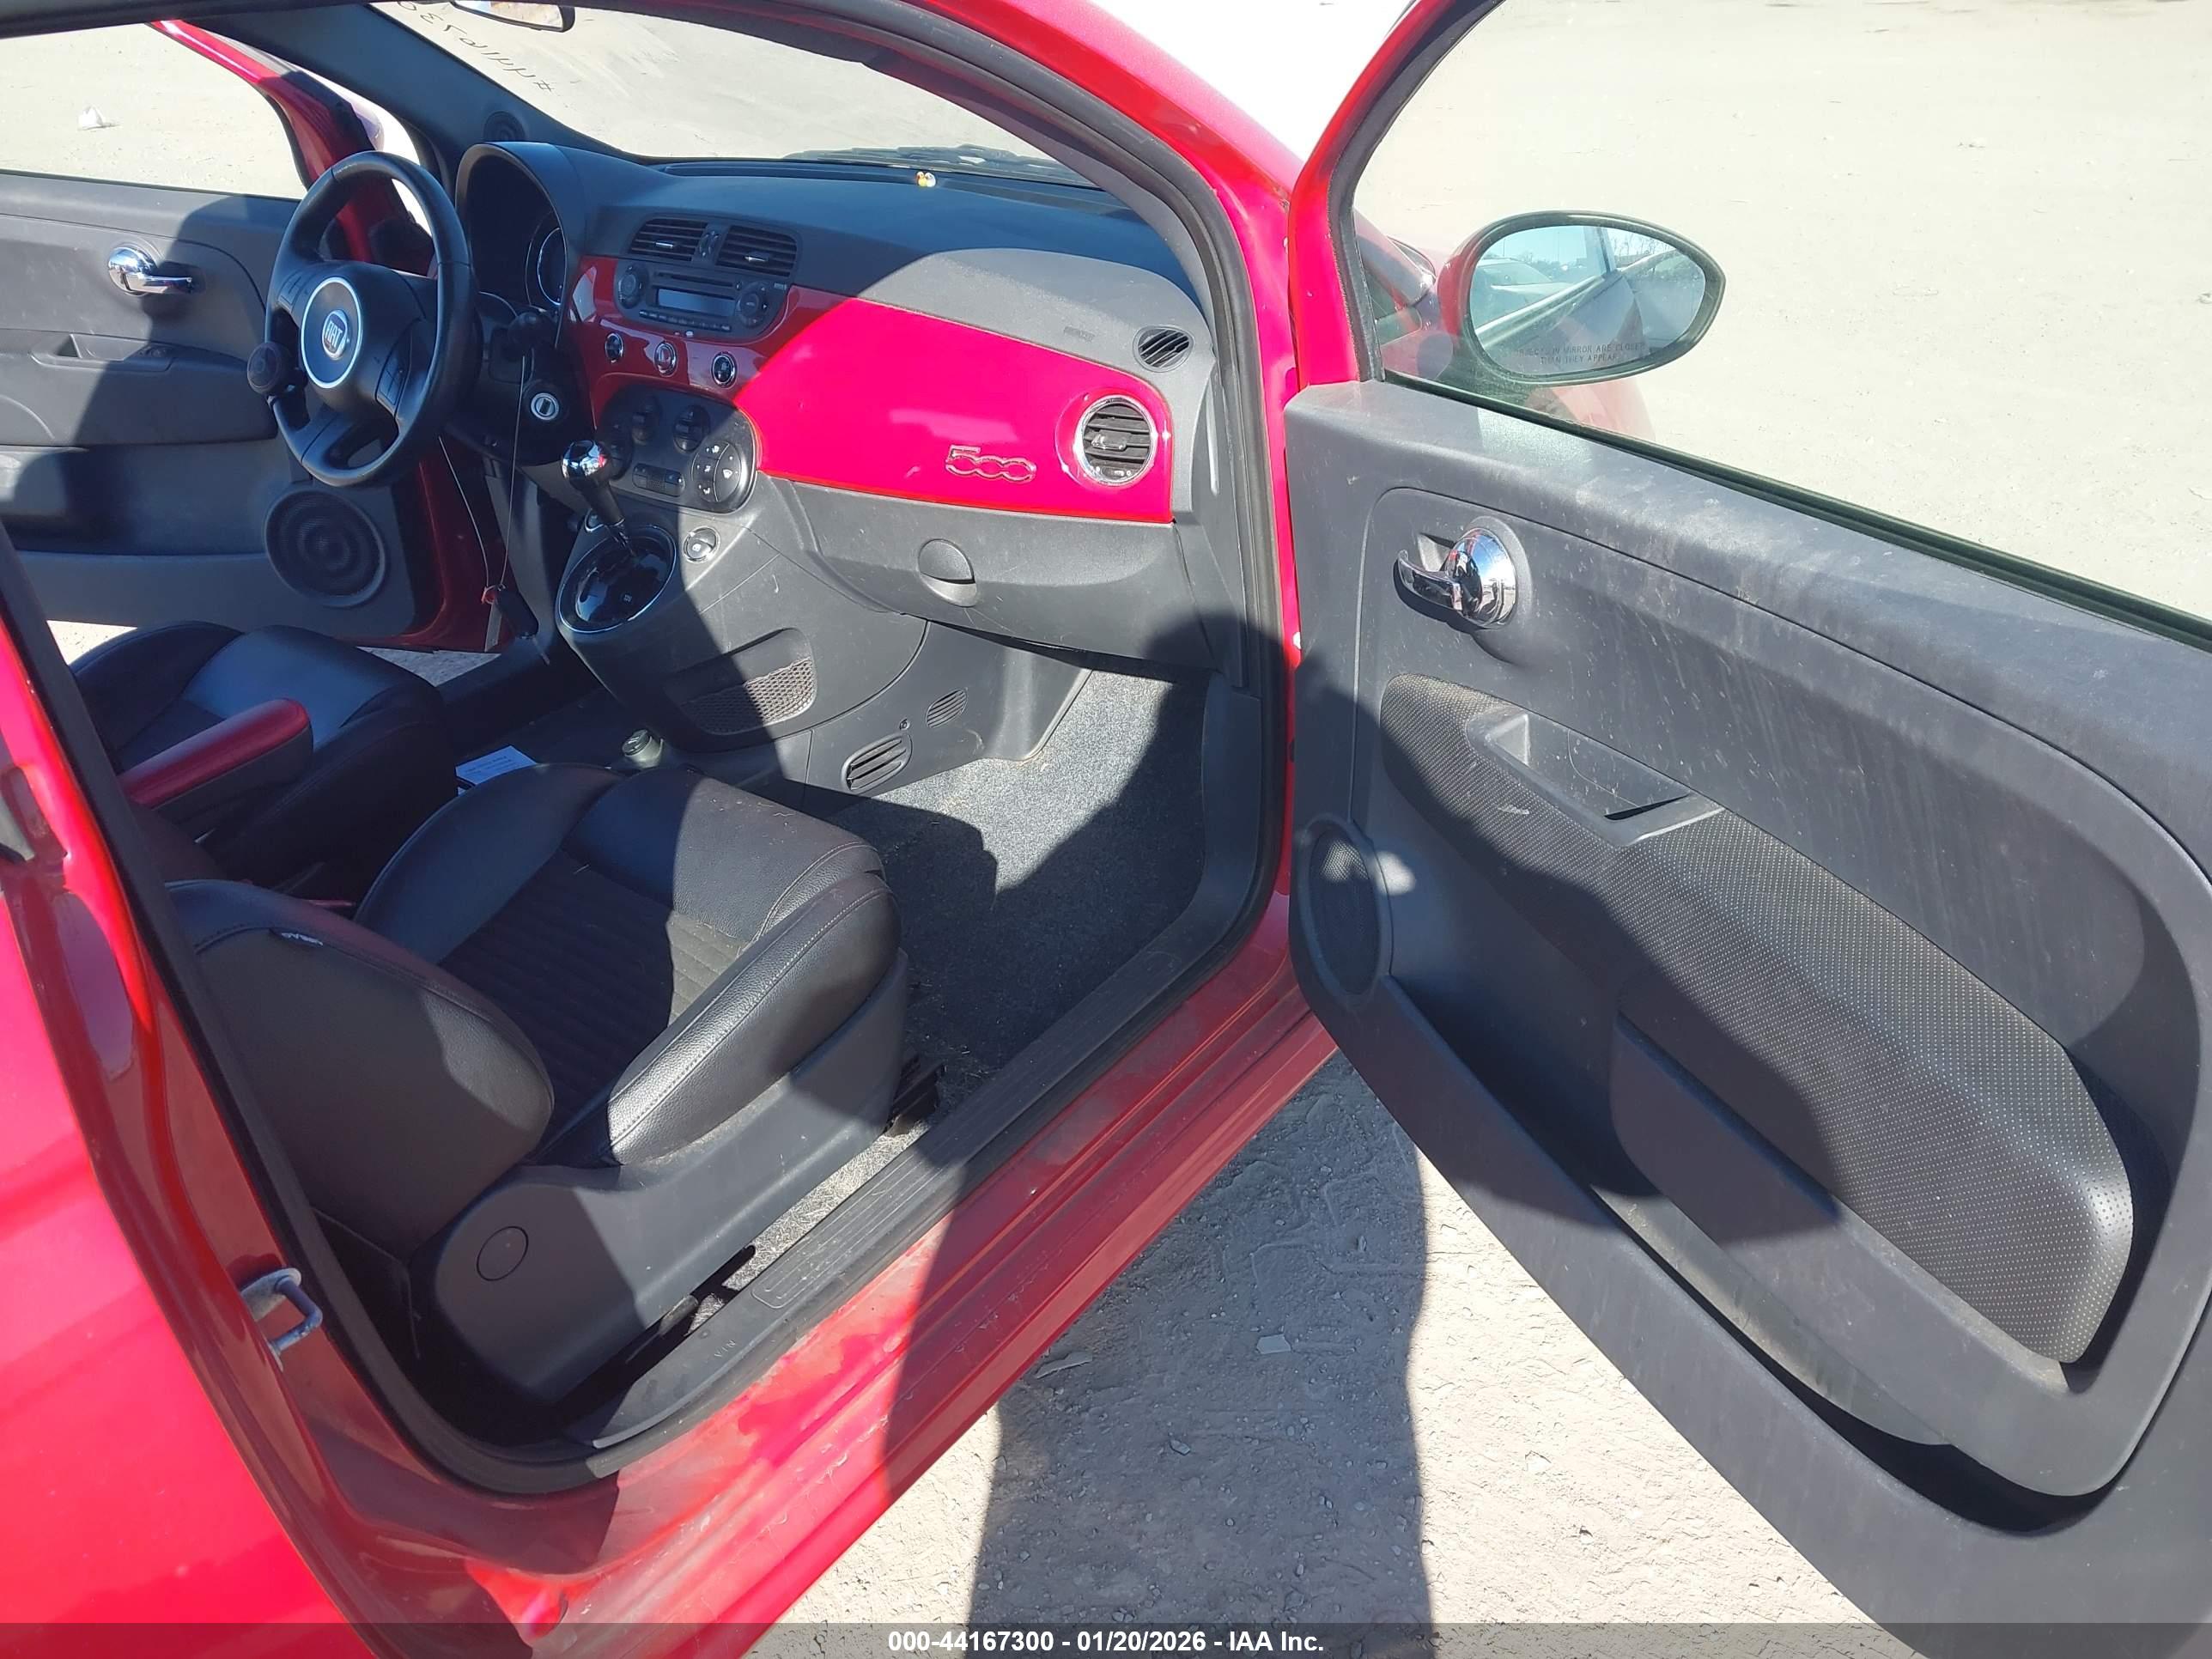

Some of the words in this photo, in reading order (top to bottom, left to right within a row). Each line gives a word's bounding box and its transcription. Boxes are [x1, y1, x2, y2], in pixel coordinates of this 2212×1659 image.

[1595, 343, 1612, 352] ARE
[1565, 355, 1585, 363] THEY
[945, 444, 1037, 484] 500
